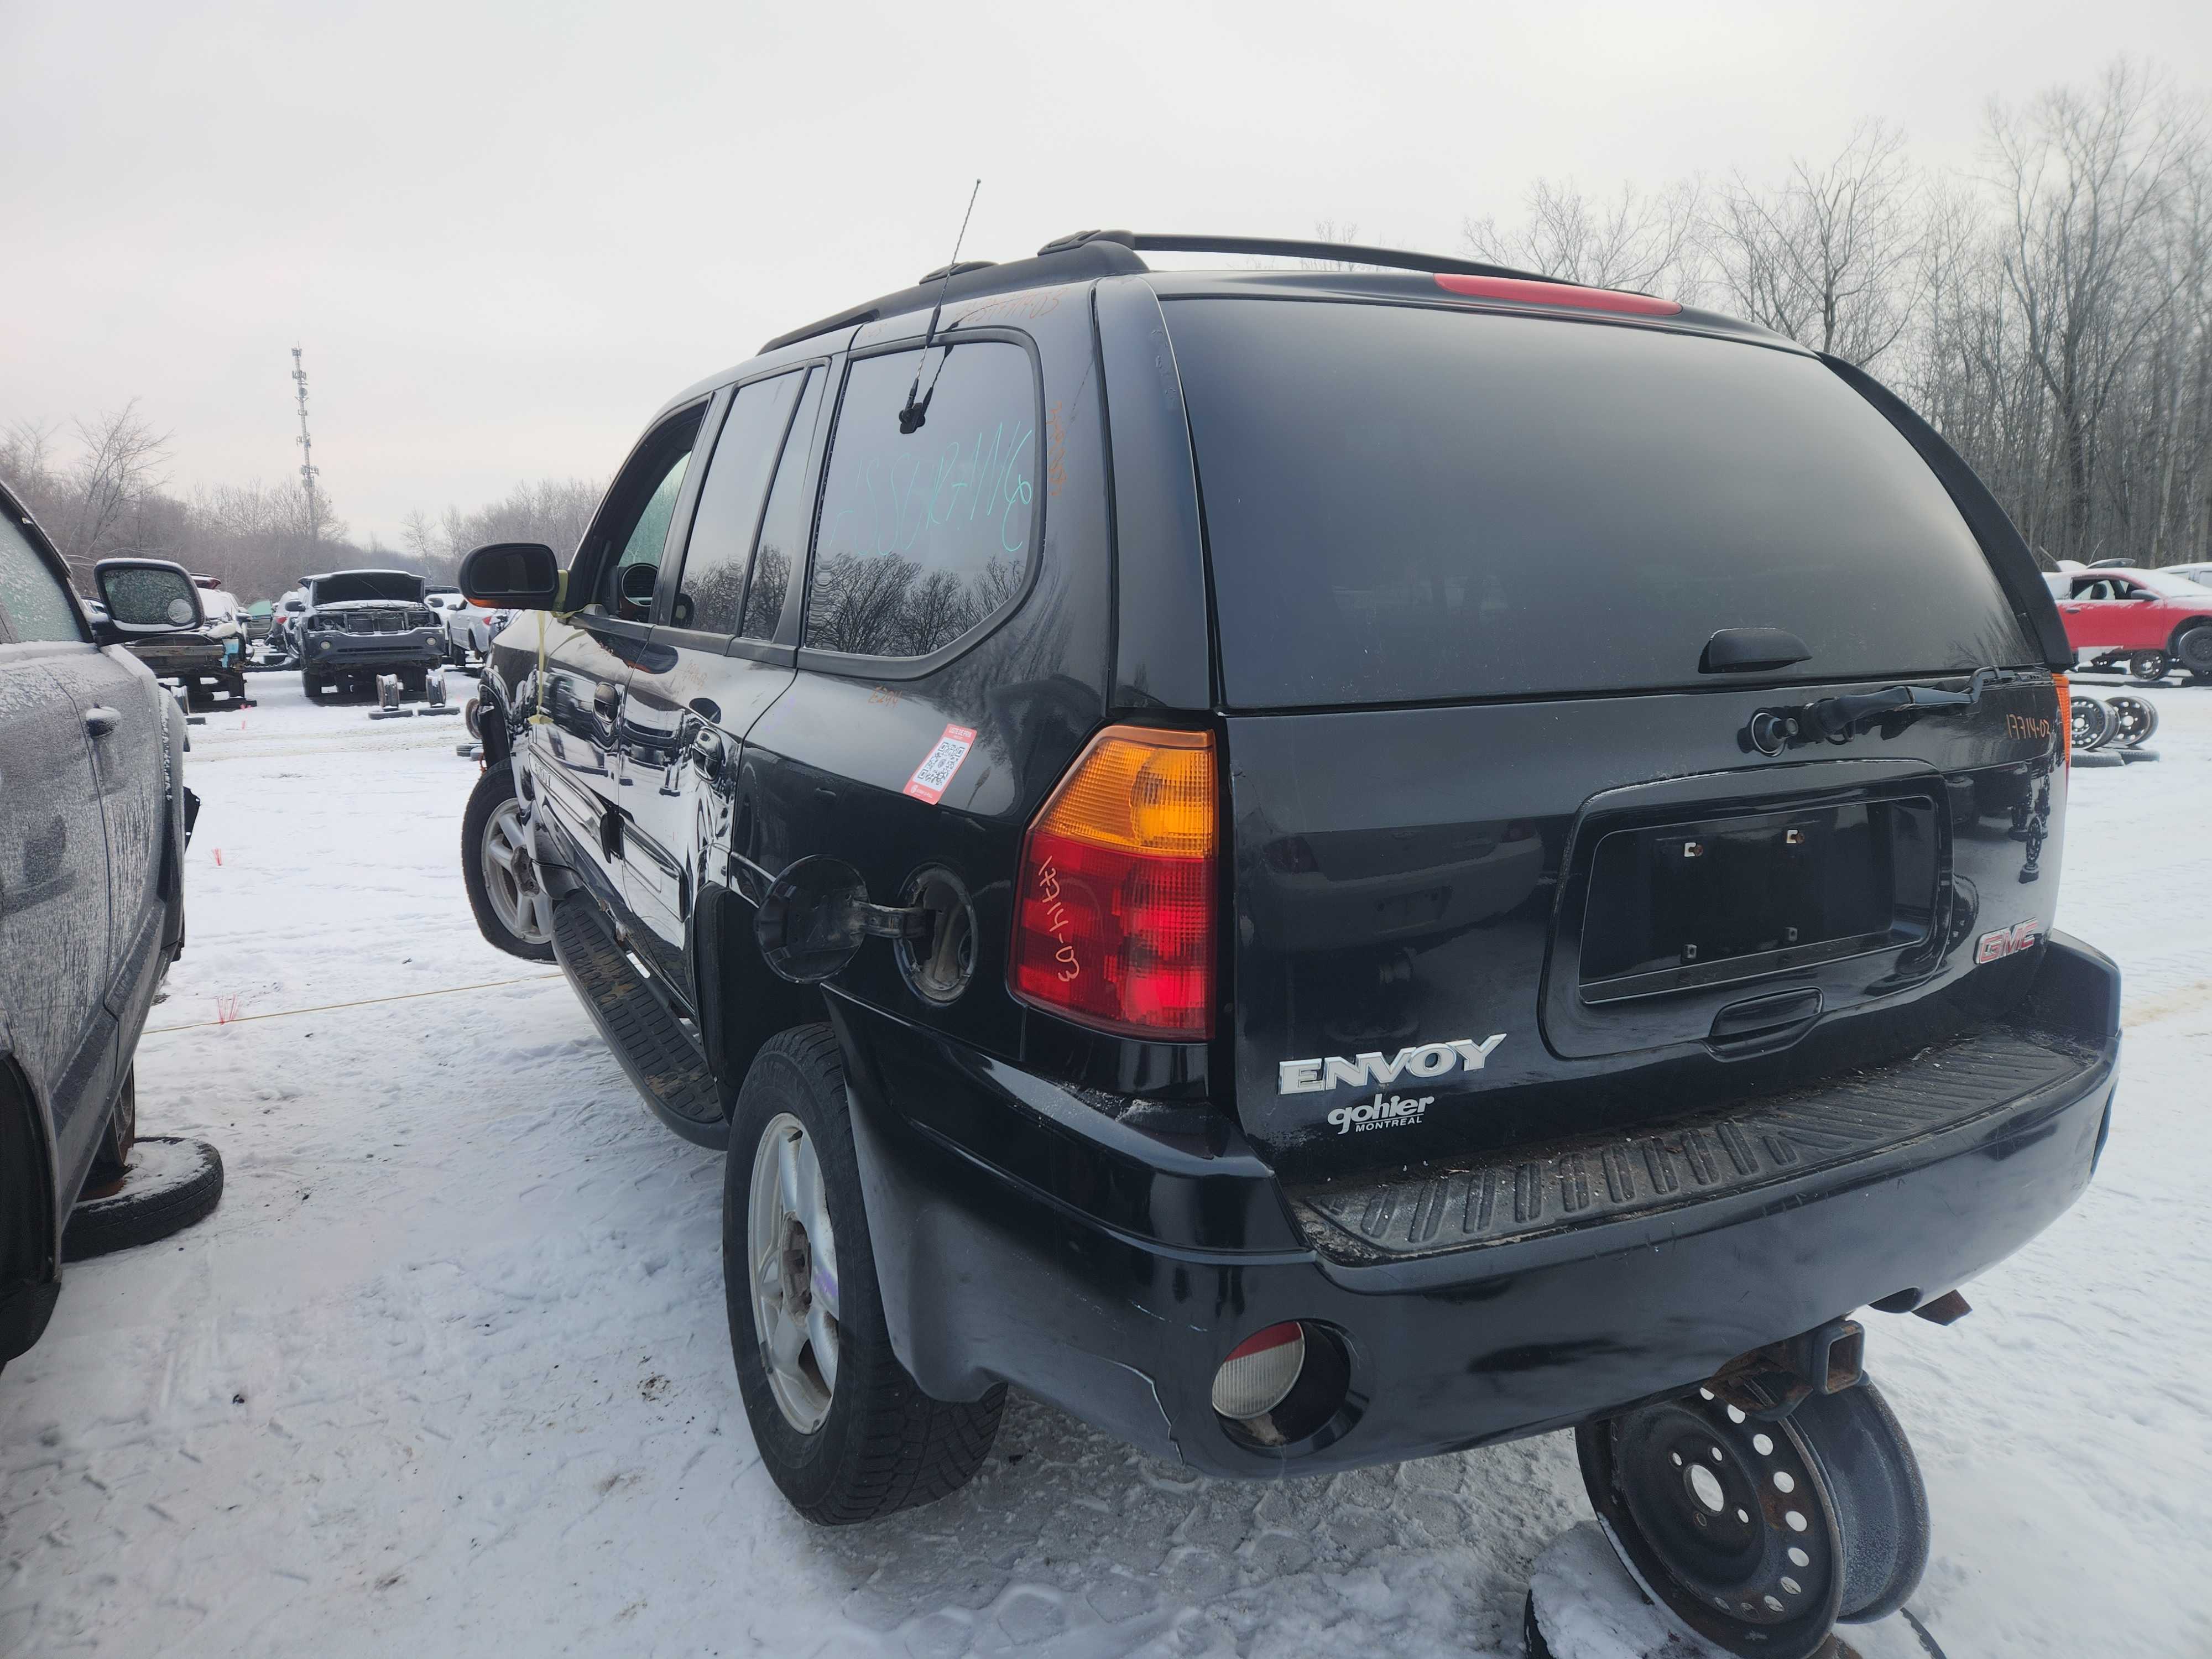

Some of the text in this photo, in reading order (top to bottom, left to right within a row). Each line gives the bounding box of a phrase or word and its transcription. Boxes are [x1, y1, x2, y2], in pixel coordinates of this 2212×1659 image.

[1038, 855, 1080, 983] 17714-03
[1974, 917, 2039, 964] GMC
[1278, 1033, 1507, 1095] ENVOY
[1328, 1094, 1435, 1135] gohier
[1355, 1115, 1423, 1133] MONTREAL
